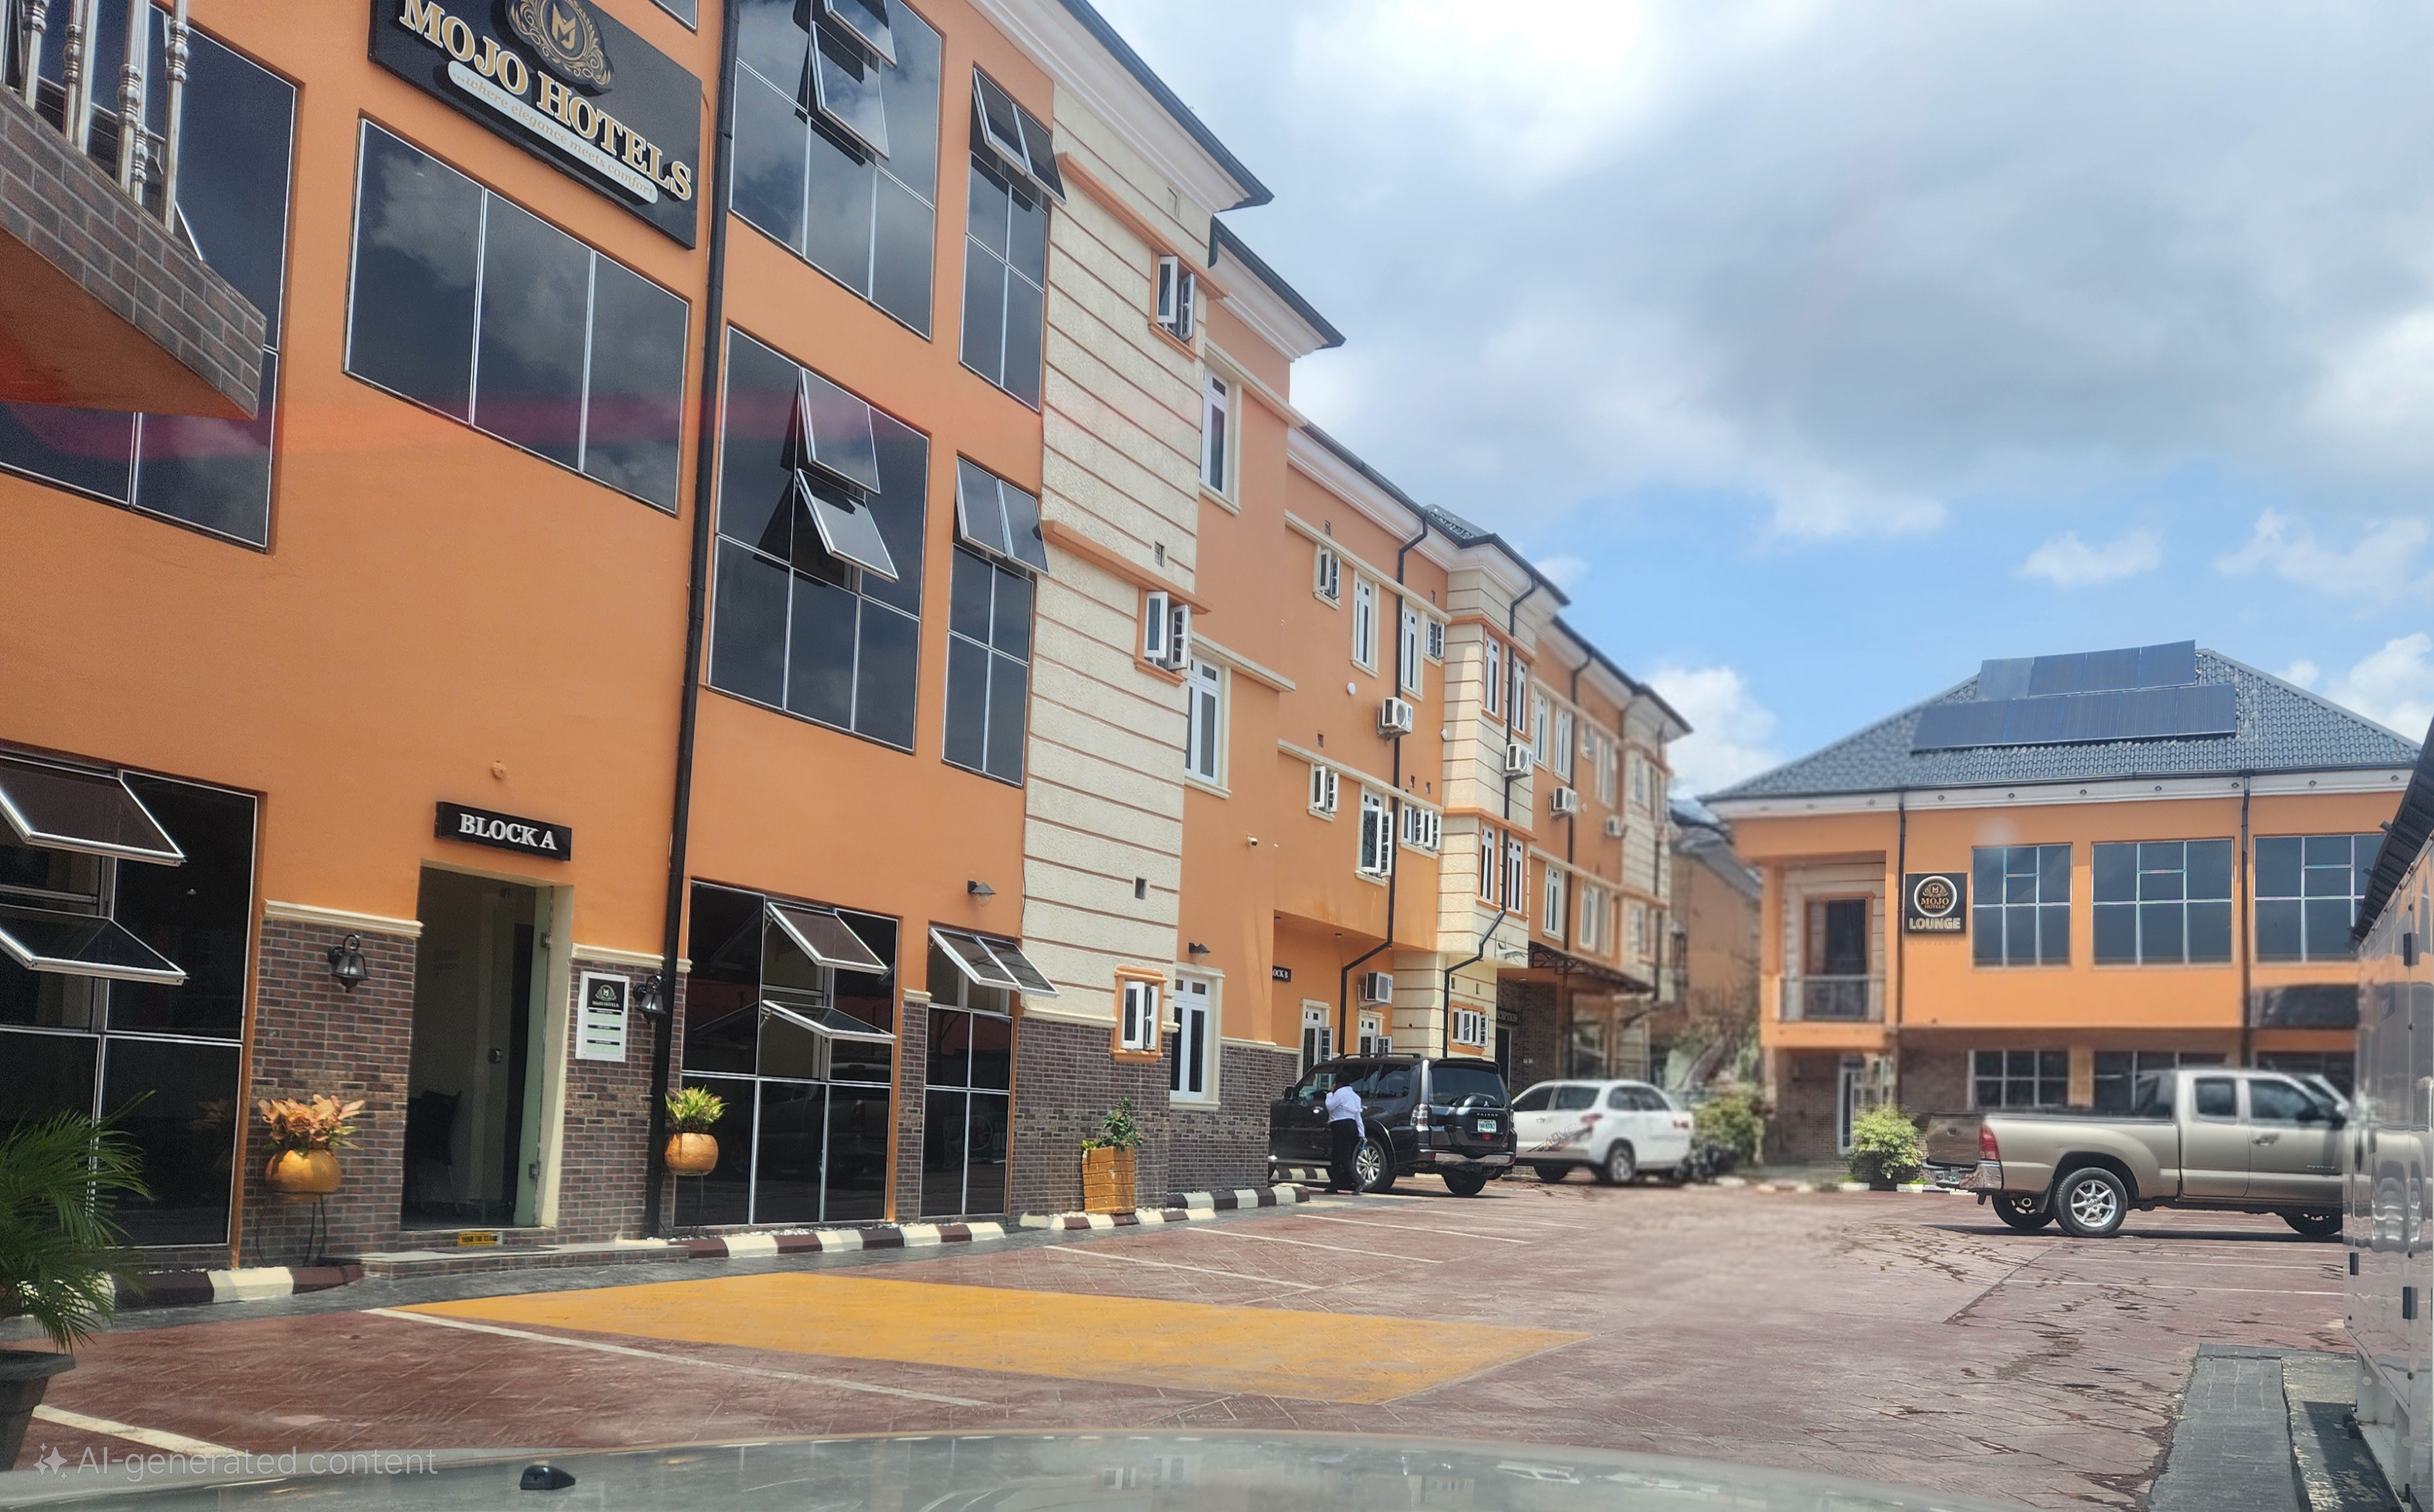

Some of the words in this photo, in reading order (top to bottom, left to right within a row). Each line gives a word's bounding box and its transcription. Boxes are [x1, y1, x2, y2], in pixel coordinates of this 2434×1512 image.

[399, 0, 528, 95] MOJO
[536, 71, 692, 201] HOTELS
[511, 104, 567, 144] elegance
[570, 140, 606, 168] meets
[608, 163, 654, 198] comfort
[458, 812, 540, 848] BLOCK
[539, 830, 559, 851] A
[1909, 917, 1961, 929] LOUNGE
[1272, 968, 1284, 978] OCK
